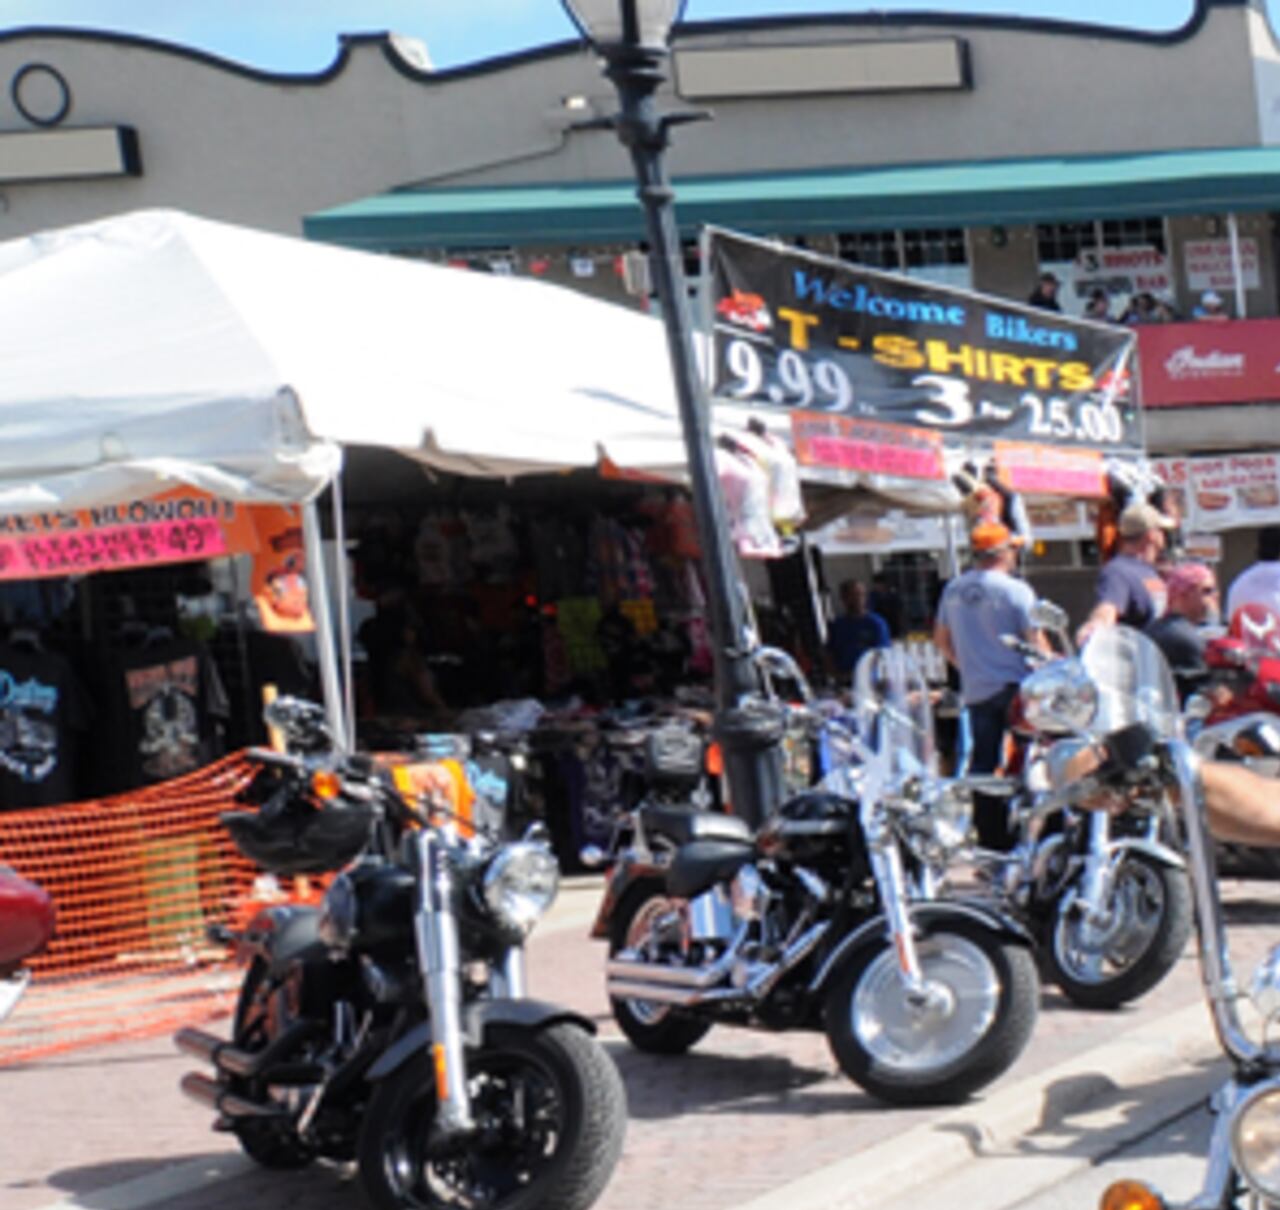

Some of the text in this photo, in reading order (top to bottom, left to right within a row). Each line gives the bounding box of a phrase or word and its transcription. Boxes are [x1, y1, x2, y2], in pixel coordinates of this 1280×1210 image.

[794, 271, 1078, 352] Welcome Bikers
[911, 375, 974, 427] 3
[1019, 391, 1123, 443] 25.00
